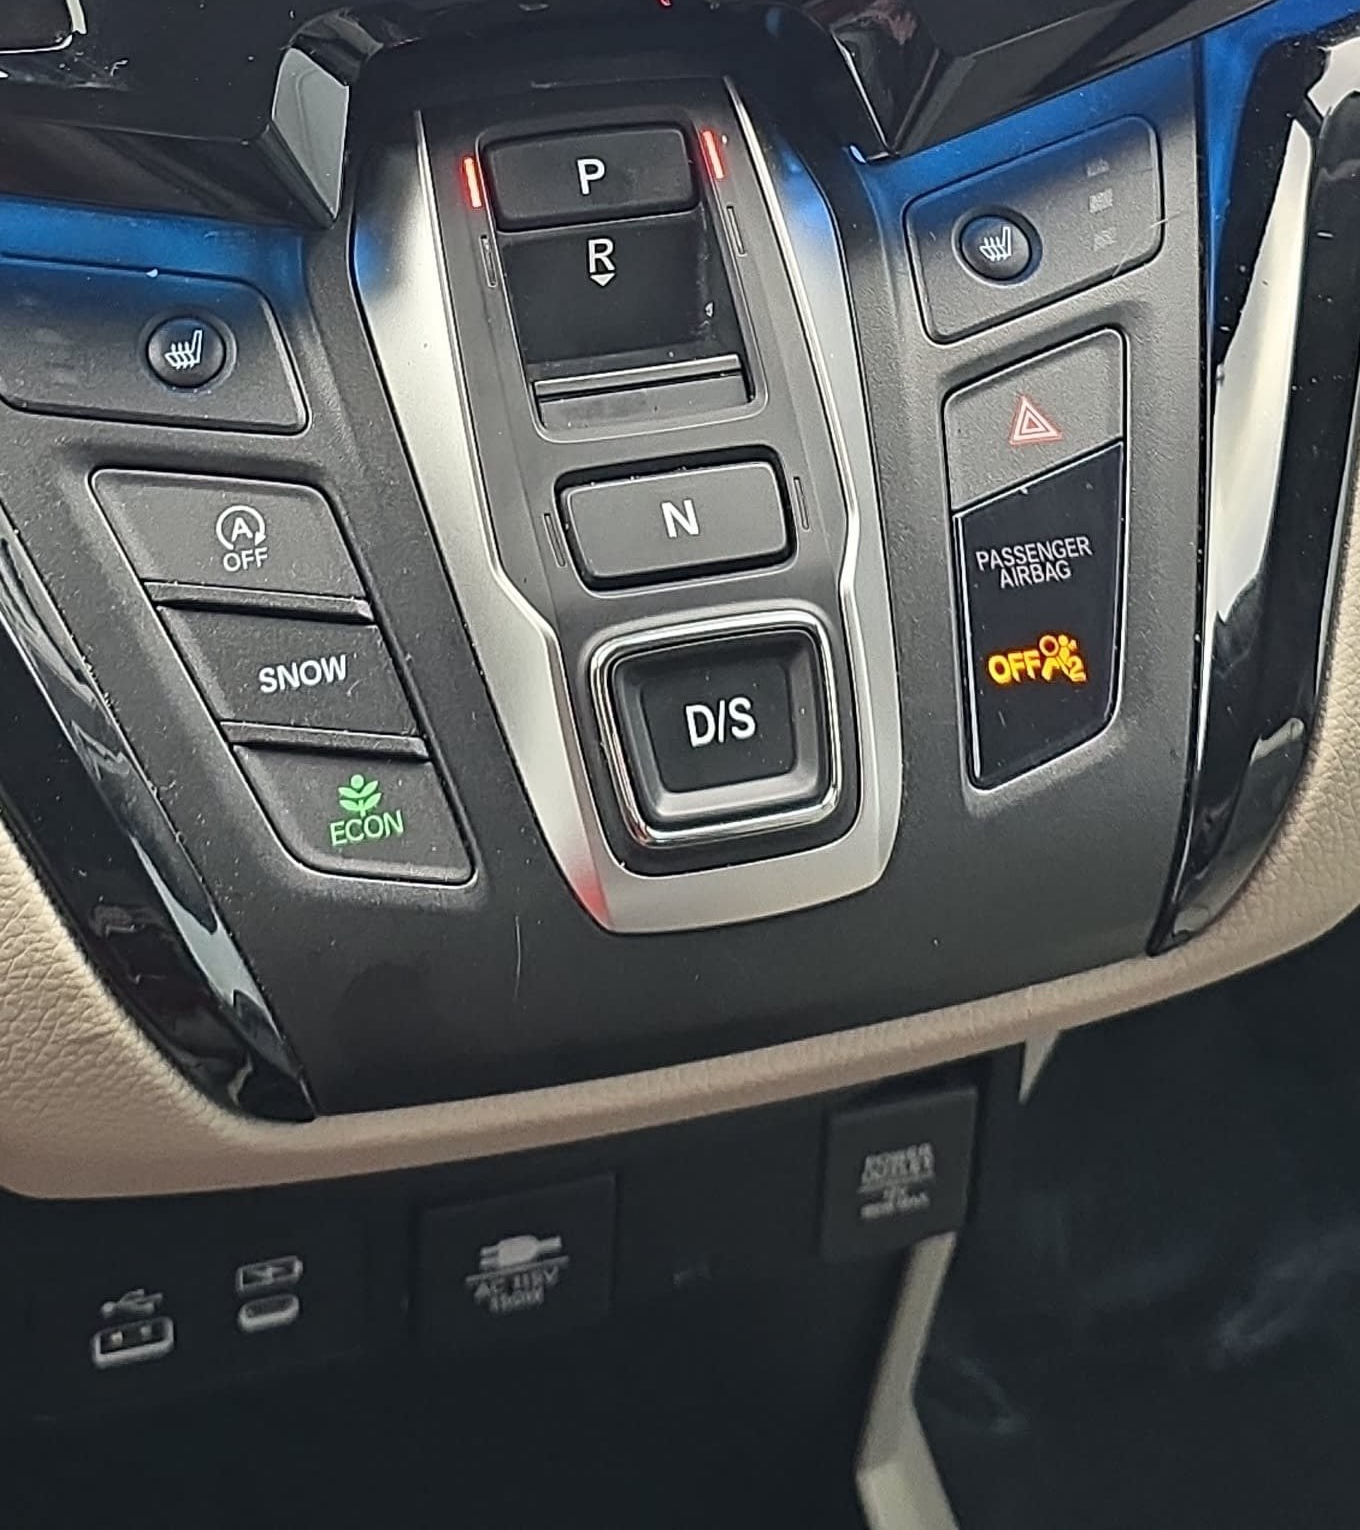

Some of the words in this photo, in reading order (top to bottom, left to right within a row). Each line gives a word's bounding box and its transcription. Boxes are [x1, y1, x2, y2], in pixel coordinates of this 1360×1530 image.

[577, 159, 606, 195] P
[587, 238, 614, 272] R
[662, 500, 700, 538] N
[222, 547, 268, 573] OFF
[975, 534, 1092, 572] PASSENGER
[999, 560, 1072, 589] AIRBAG
[258, 654, 347, 694] SNOW
[988, 650, 1042, 684] OFF
[685, 696, 757, 748] D/S
[330, 810, 404, 846] ECON
